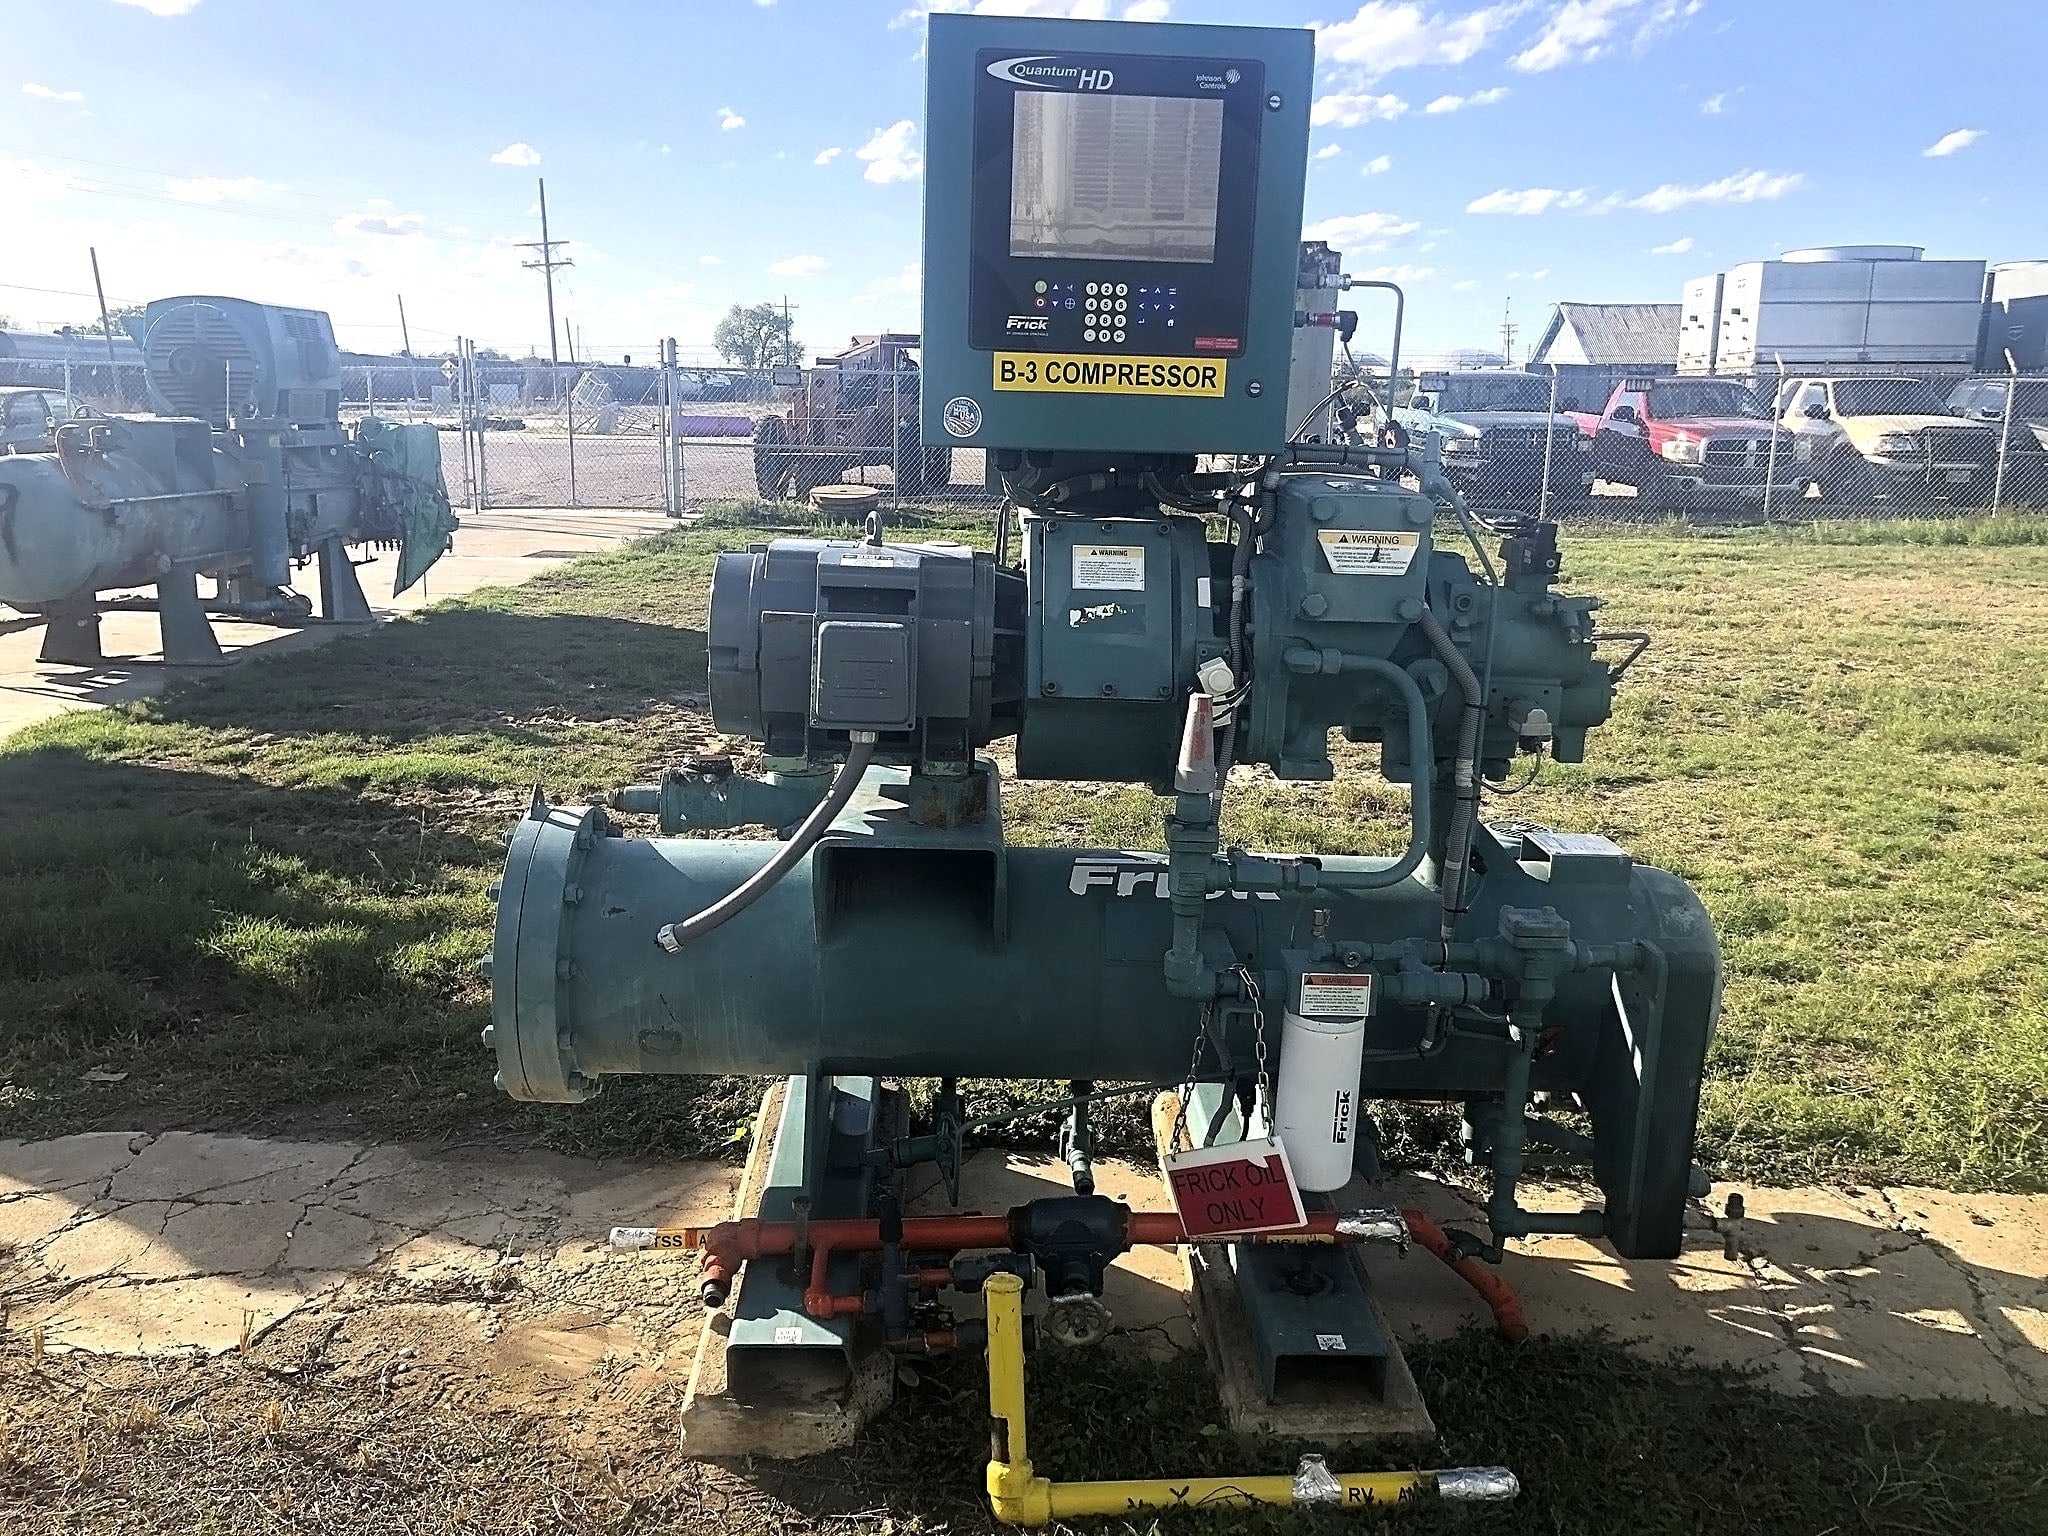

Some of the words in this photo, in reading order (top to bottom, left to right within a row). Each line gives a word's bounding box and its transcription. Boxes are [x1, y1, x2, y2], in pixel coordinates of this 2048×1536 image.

[1014, 64, 1078, 77] Quantum
[1078, 69, 1114, 90] HD
[1195, 74, 1222, 82] Johnson
[1199, 82, 1227, 90] Controls
[1006, 319, 1048, 330] Frick
[1001, 360, 1038, 384] B-3
[1045, 361, 1217, 389] COMPRESSOR
[1351, 534, 1400, 545] WARNING
[1098, 549, 1128, 557] WARNING
[1336, 1090, 1350, 1143] Frick
[1173, 1166, 1241, 1197] FRICK
[1245, 1163, 1284, 1186] OIL
[1207, 1197, 1265, 1225] ONLY
